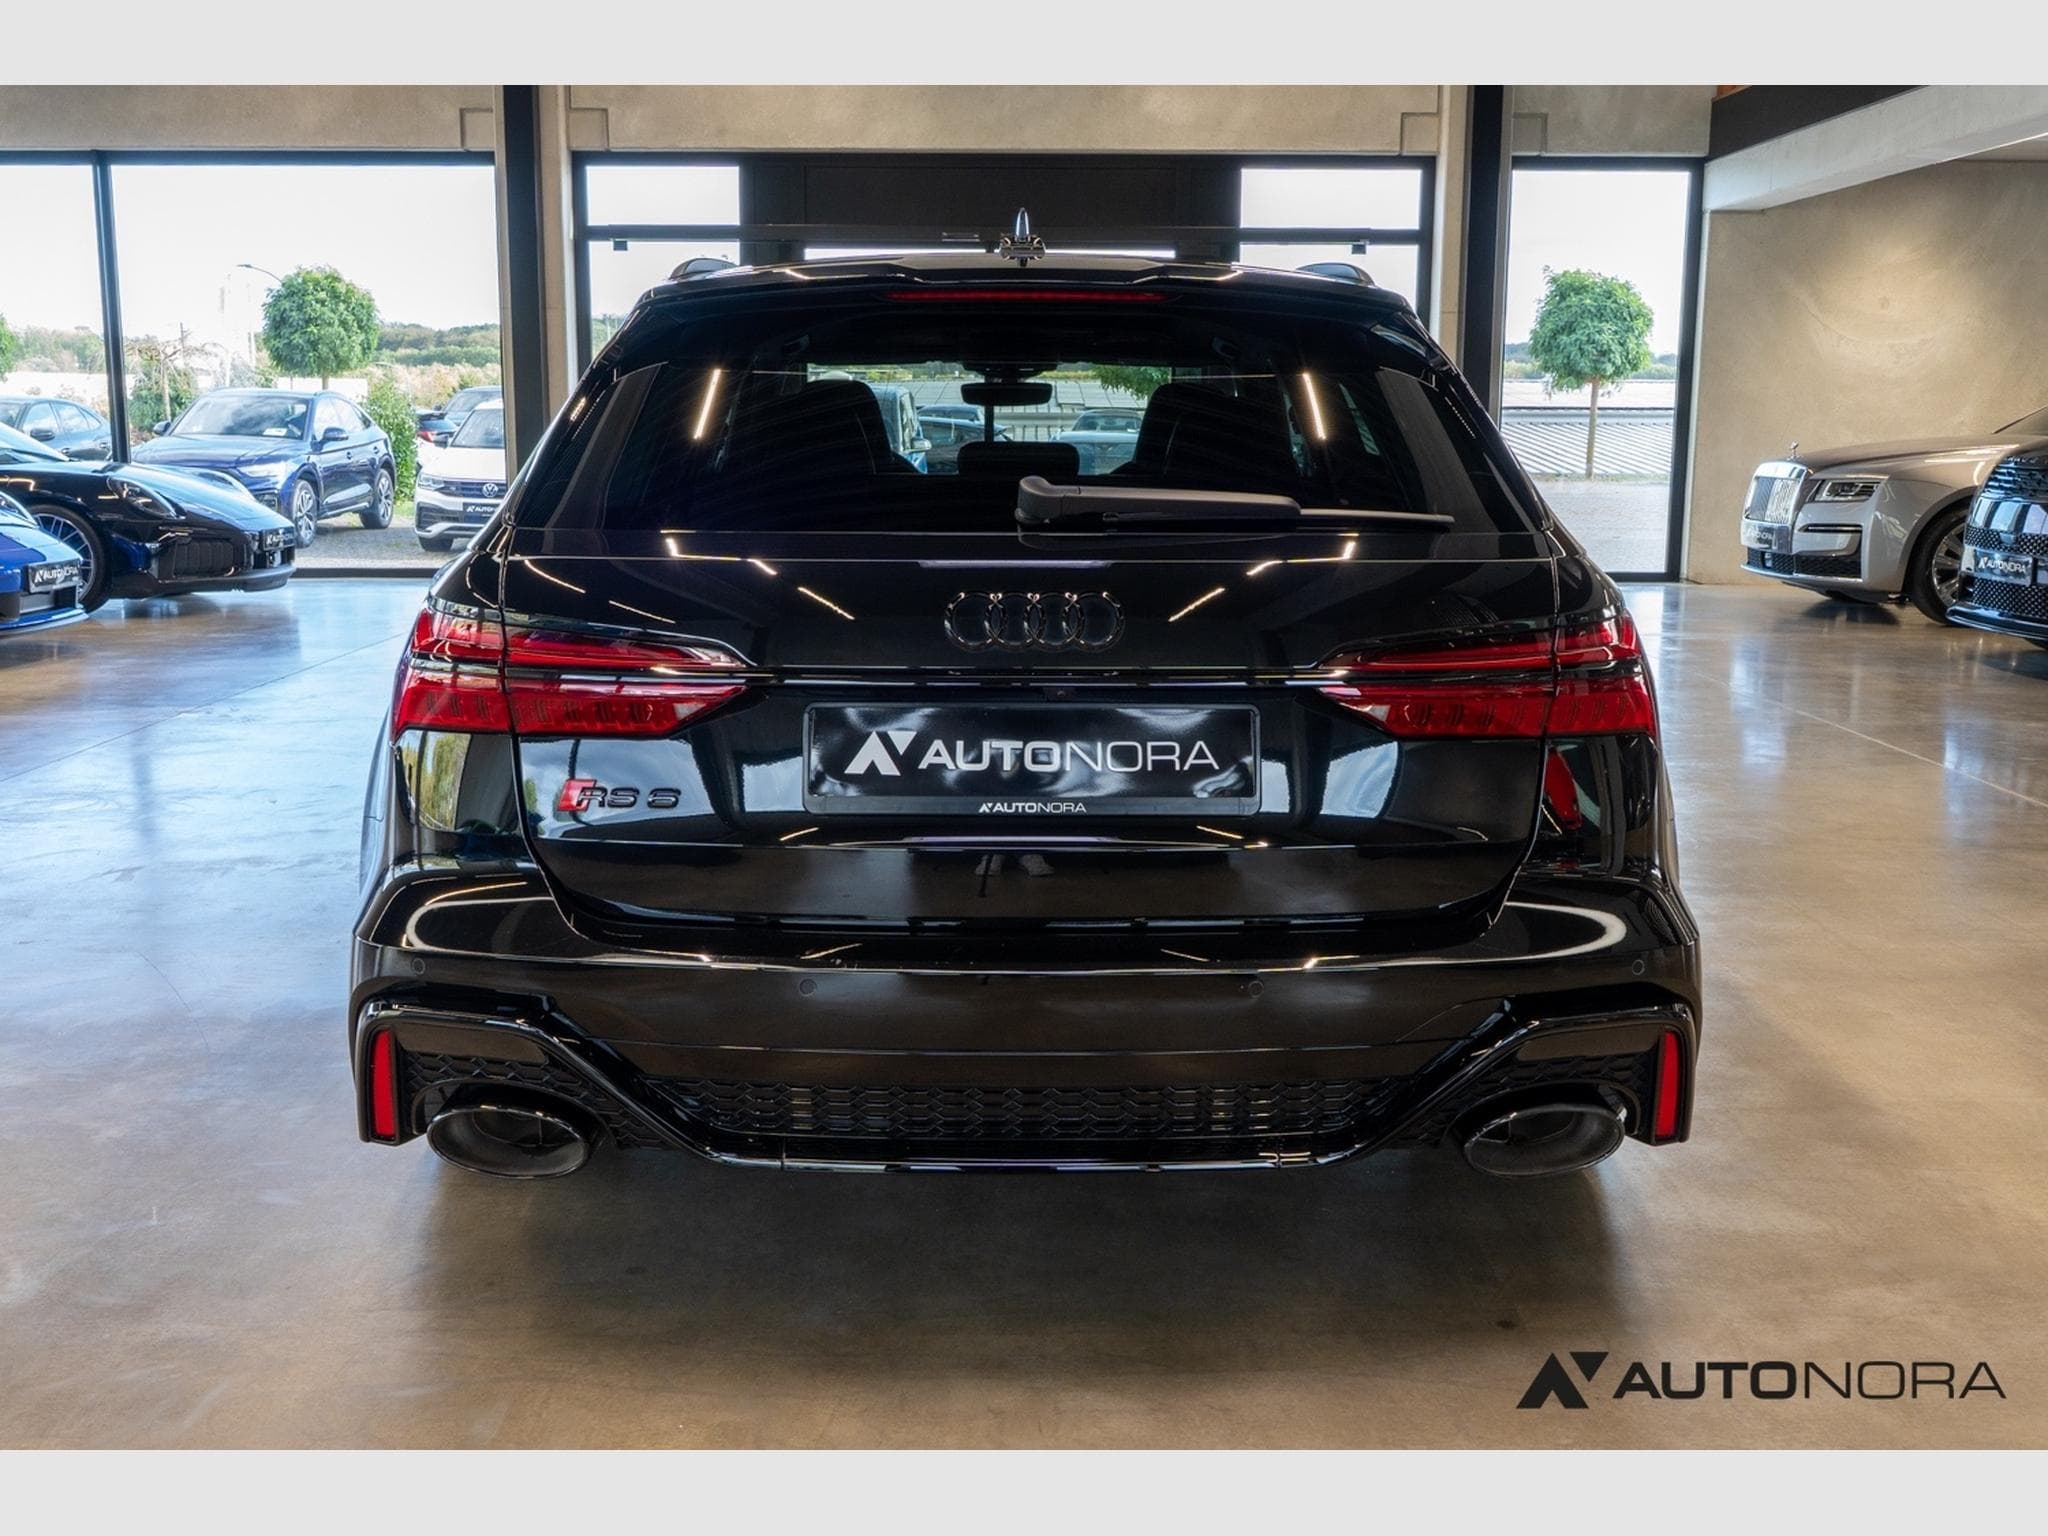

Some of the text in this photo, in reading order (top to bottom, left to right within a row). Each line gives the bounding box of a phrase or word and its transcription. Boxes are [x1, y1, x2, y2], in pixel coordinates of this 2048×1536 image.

[1986, 559, 2027, 574] AUTONORA
[917, 738, 1220, 772] AUTONORA
[573, 785, 682, 808] RS 6
[991, 801, 1087, 814] AUTONORA
